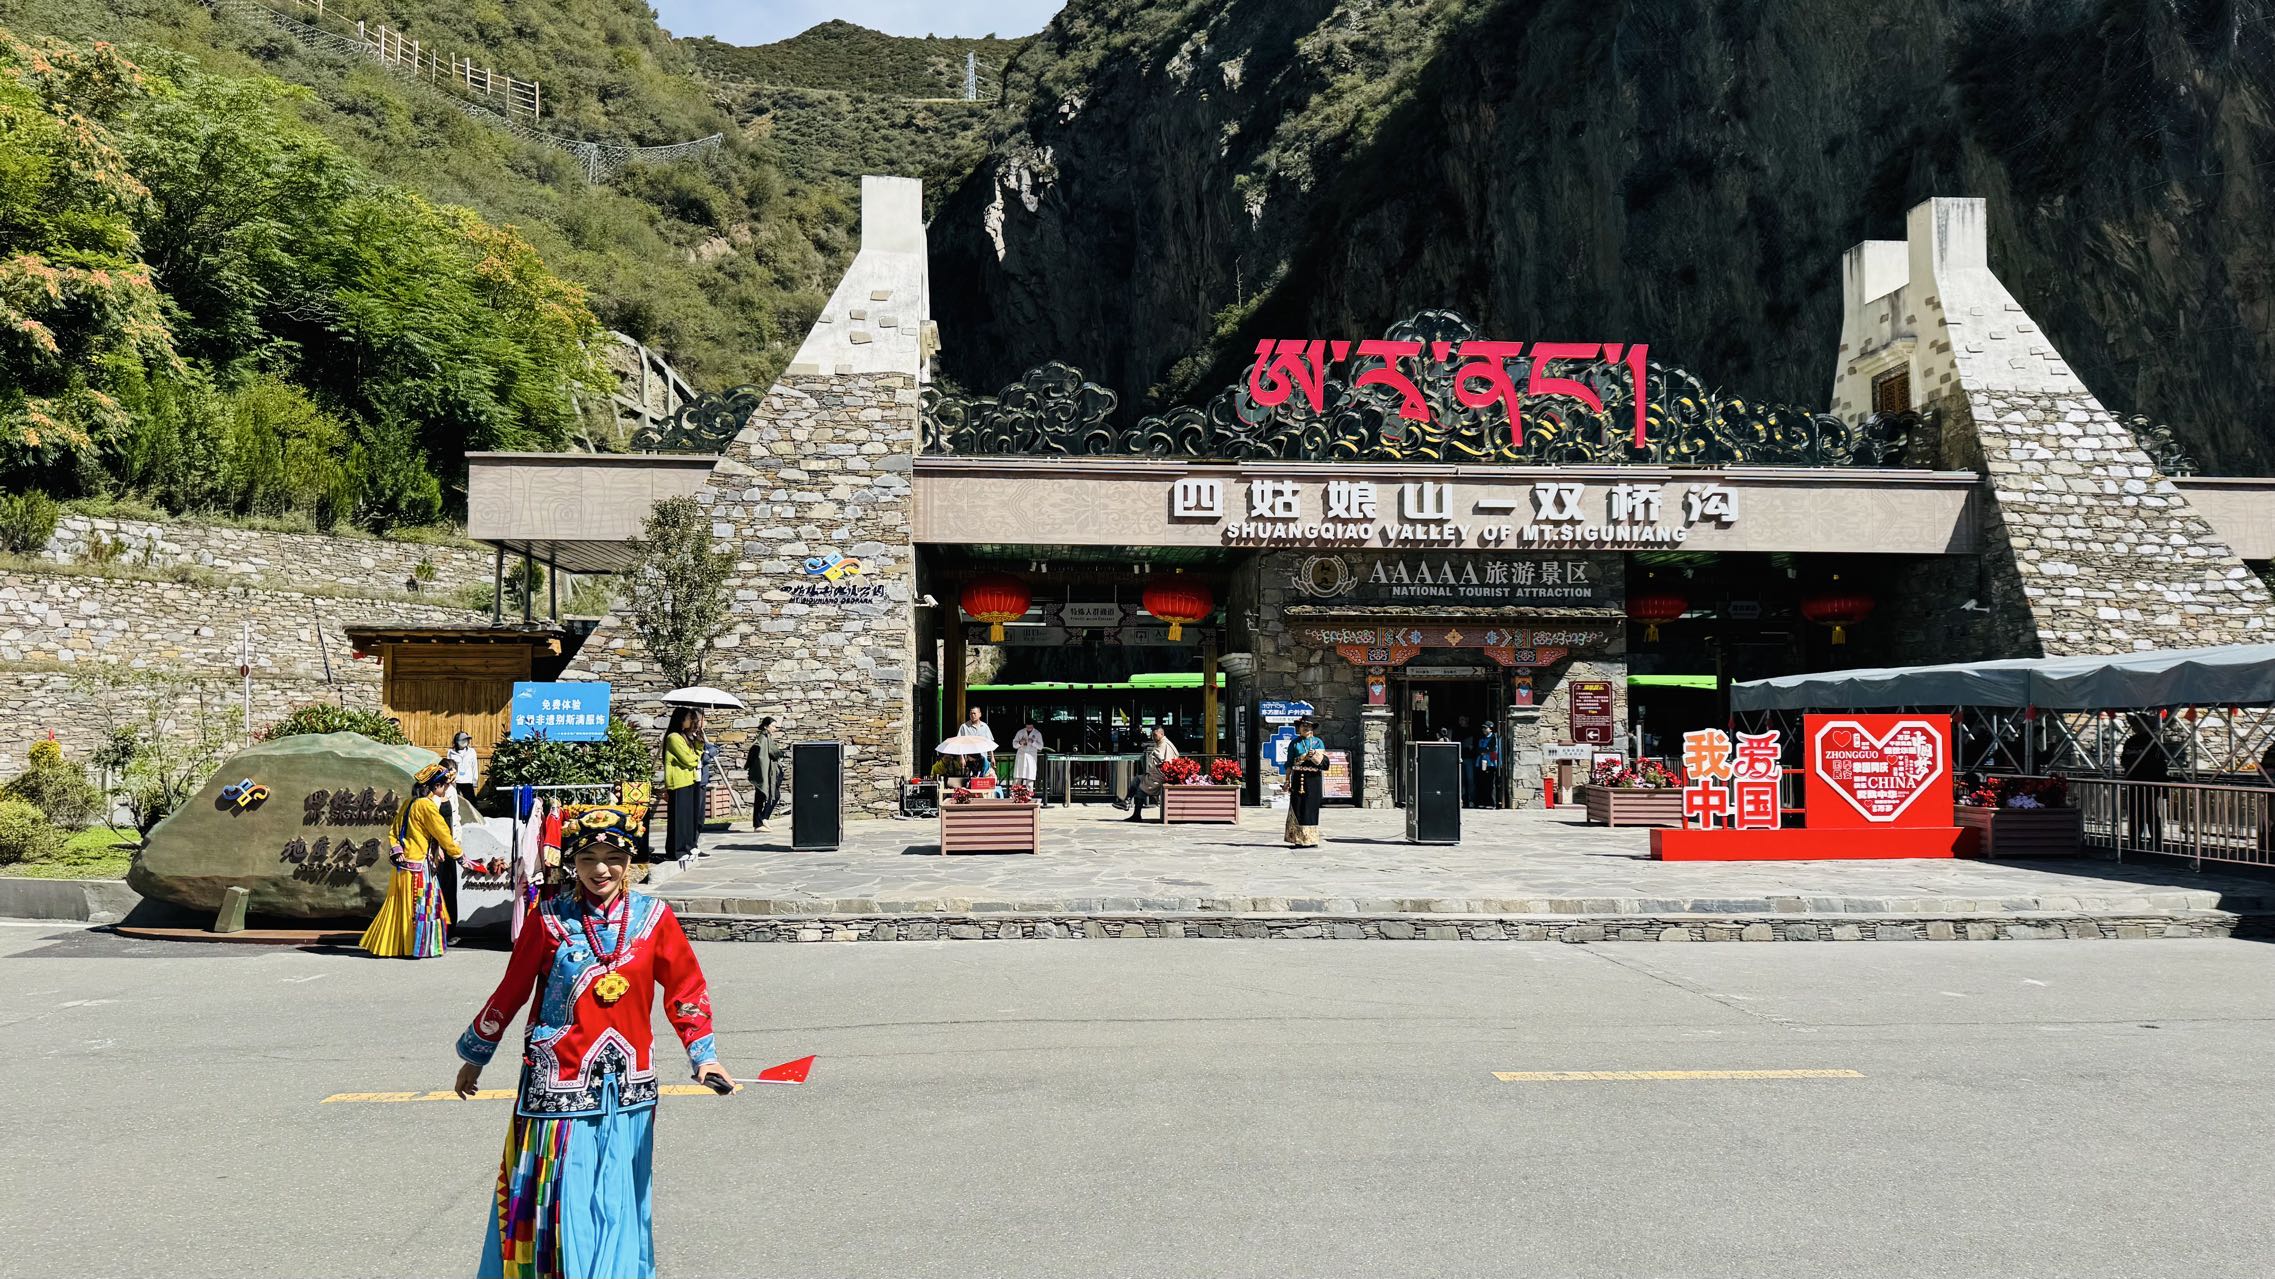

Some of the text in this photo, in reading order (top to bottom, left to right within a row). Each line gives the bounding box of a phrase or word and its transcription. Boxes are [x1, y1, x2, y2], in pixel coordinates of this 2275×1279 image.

[1226, 523, 1688, 542] SHUANGQIAO VALLEY OF MT.SIGUNIANG
[1392, 586, 1592, 597] NATIONAL TOURIST ATTRACTION
[542, 699, 582, 711] 免费体验
[1825, 750, 1879, 760] ZHONGGUO
[1867, 776, 1917, 788] CHINA
[1684, 780, 1781, 830] 中国
